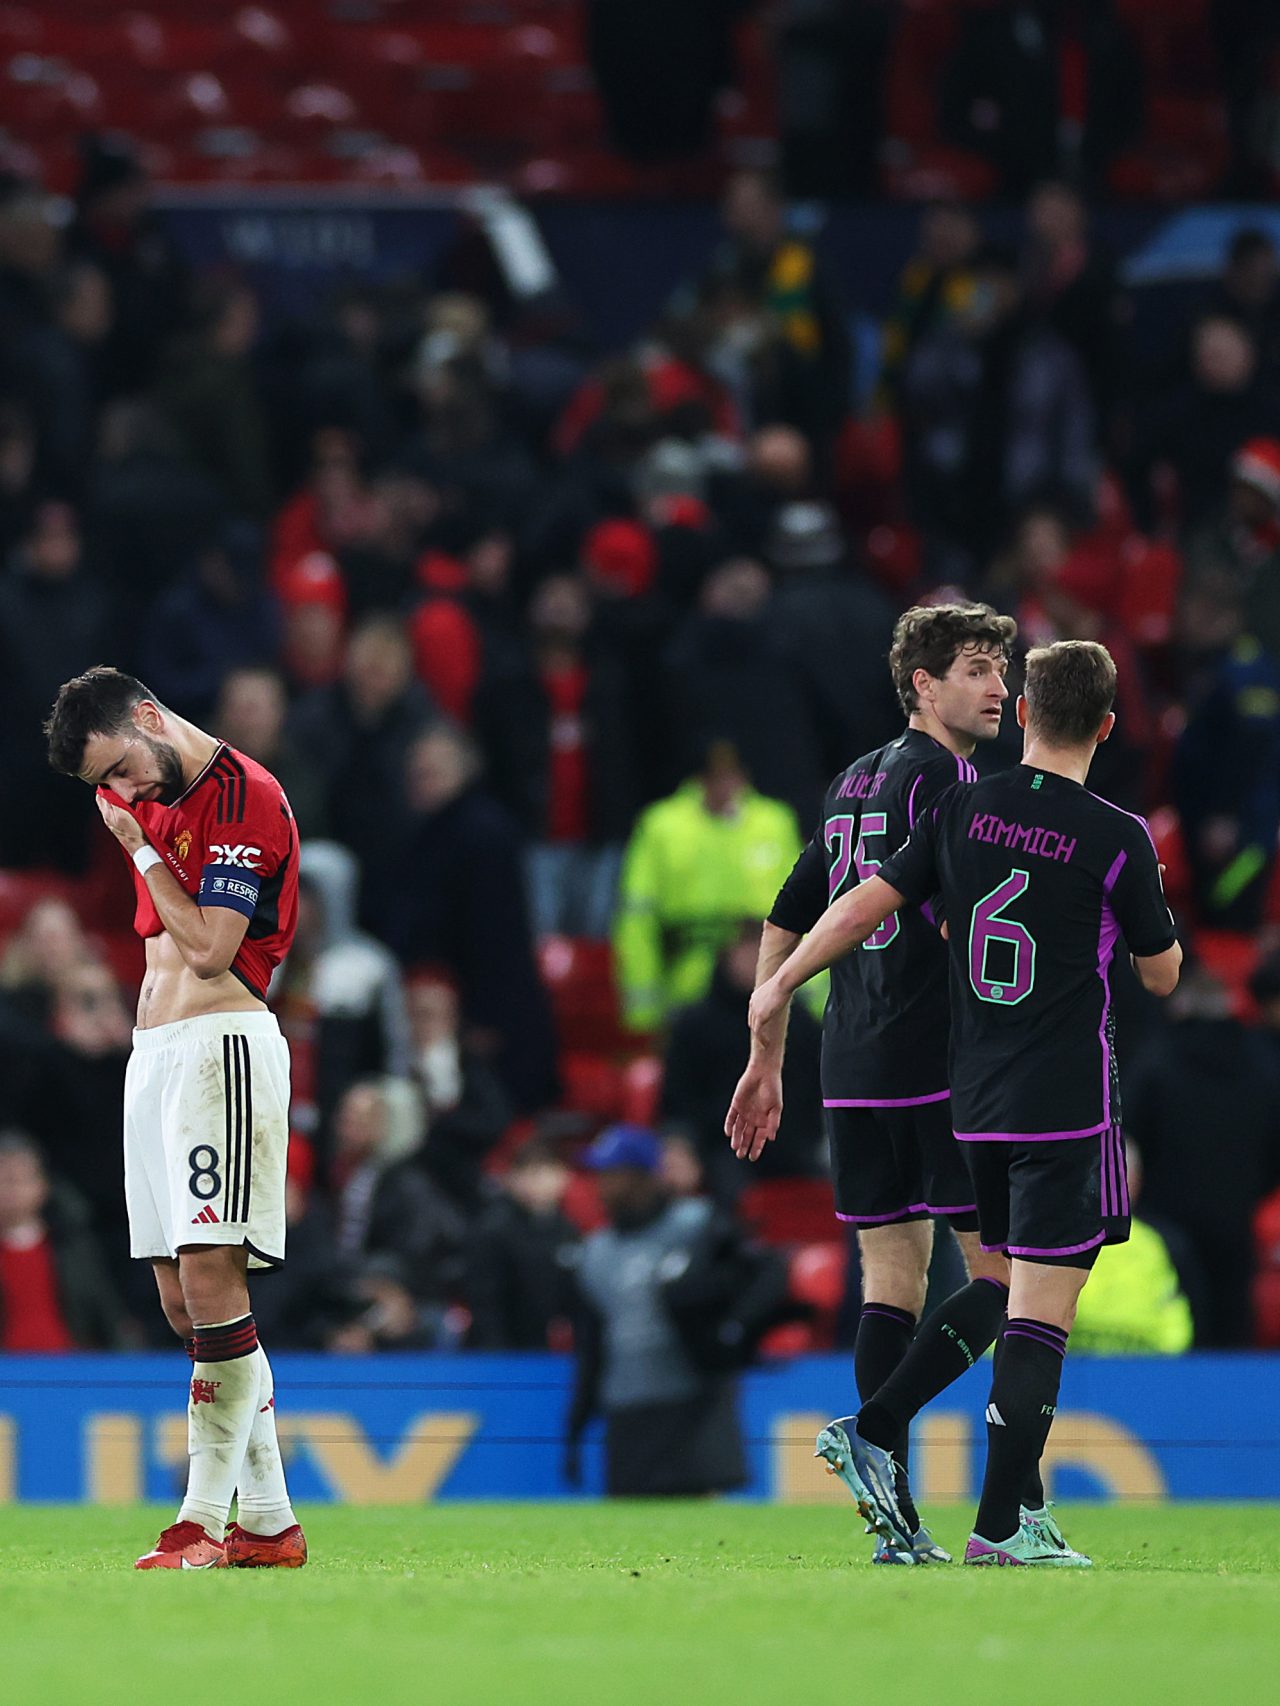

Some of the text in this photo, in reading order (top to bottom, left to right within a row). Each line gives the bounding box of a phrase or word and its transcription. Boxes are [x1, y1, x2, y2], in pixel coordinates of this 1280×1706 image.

[209, 844, 262, 869] DXC
[968, 812, 1078, 864] KIMMICH
[227, 881, 258, 903] RESPEC
[969, 868, 1036, 1005] 6
[188, 1144, 222, 1200] 8
[941, 1323, 975, 1367] FC BAYE
[1040, 1404, 1053, 1415] FC
